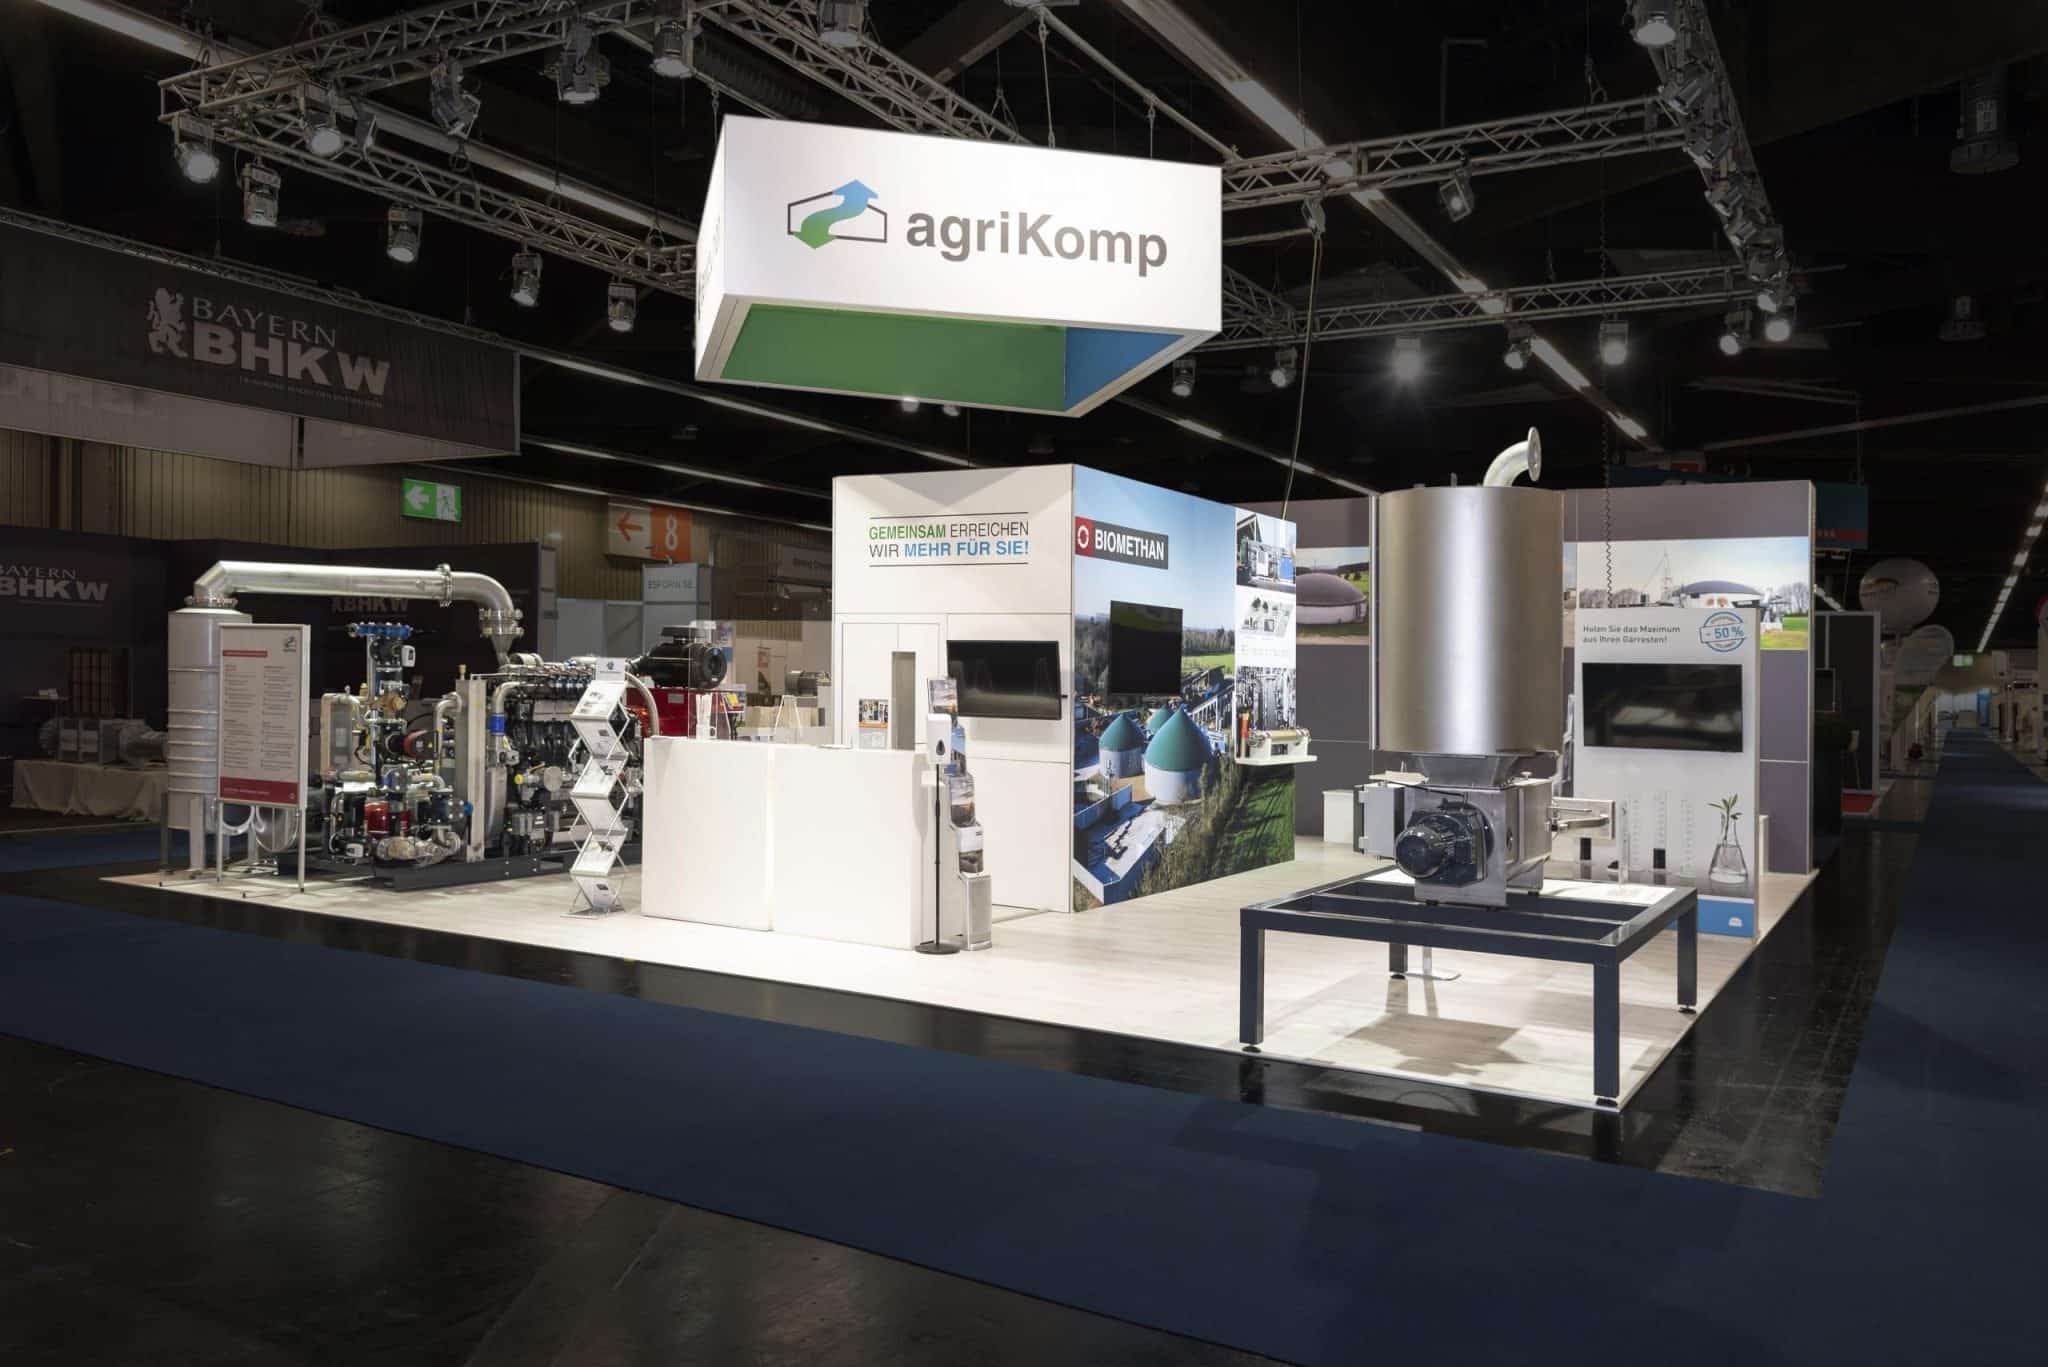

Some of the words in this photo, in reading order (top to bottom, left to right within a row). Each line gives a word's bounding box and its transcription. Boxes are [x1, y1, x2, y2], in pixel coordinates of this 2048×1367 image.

[906, 211, 1168, 277] agriKomp
[192, 297, 337, 347] BAYERN
[664, 514, 678, 551] 8
[869, 524, 946, 540] GEMEINSAM
[950, 522, 1029, 538] ERREICHEN
[1094, 528, 1165, 561] BIOMETHAN
[869, 544, 900, 558] WIR
[904, 542, 951, 558] MEHR
[957, 538, 991, 557] FÜR
[996, 540, 1029, 556] SIE!
[1639, 624, 1681, 633] Maximum
